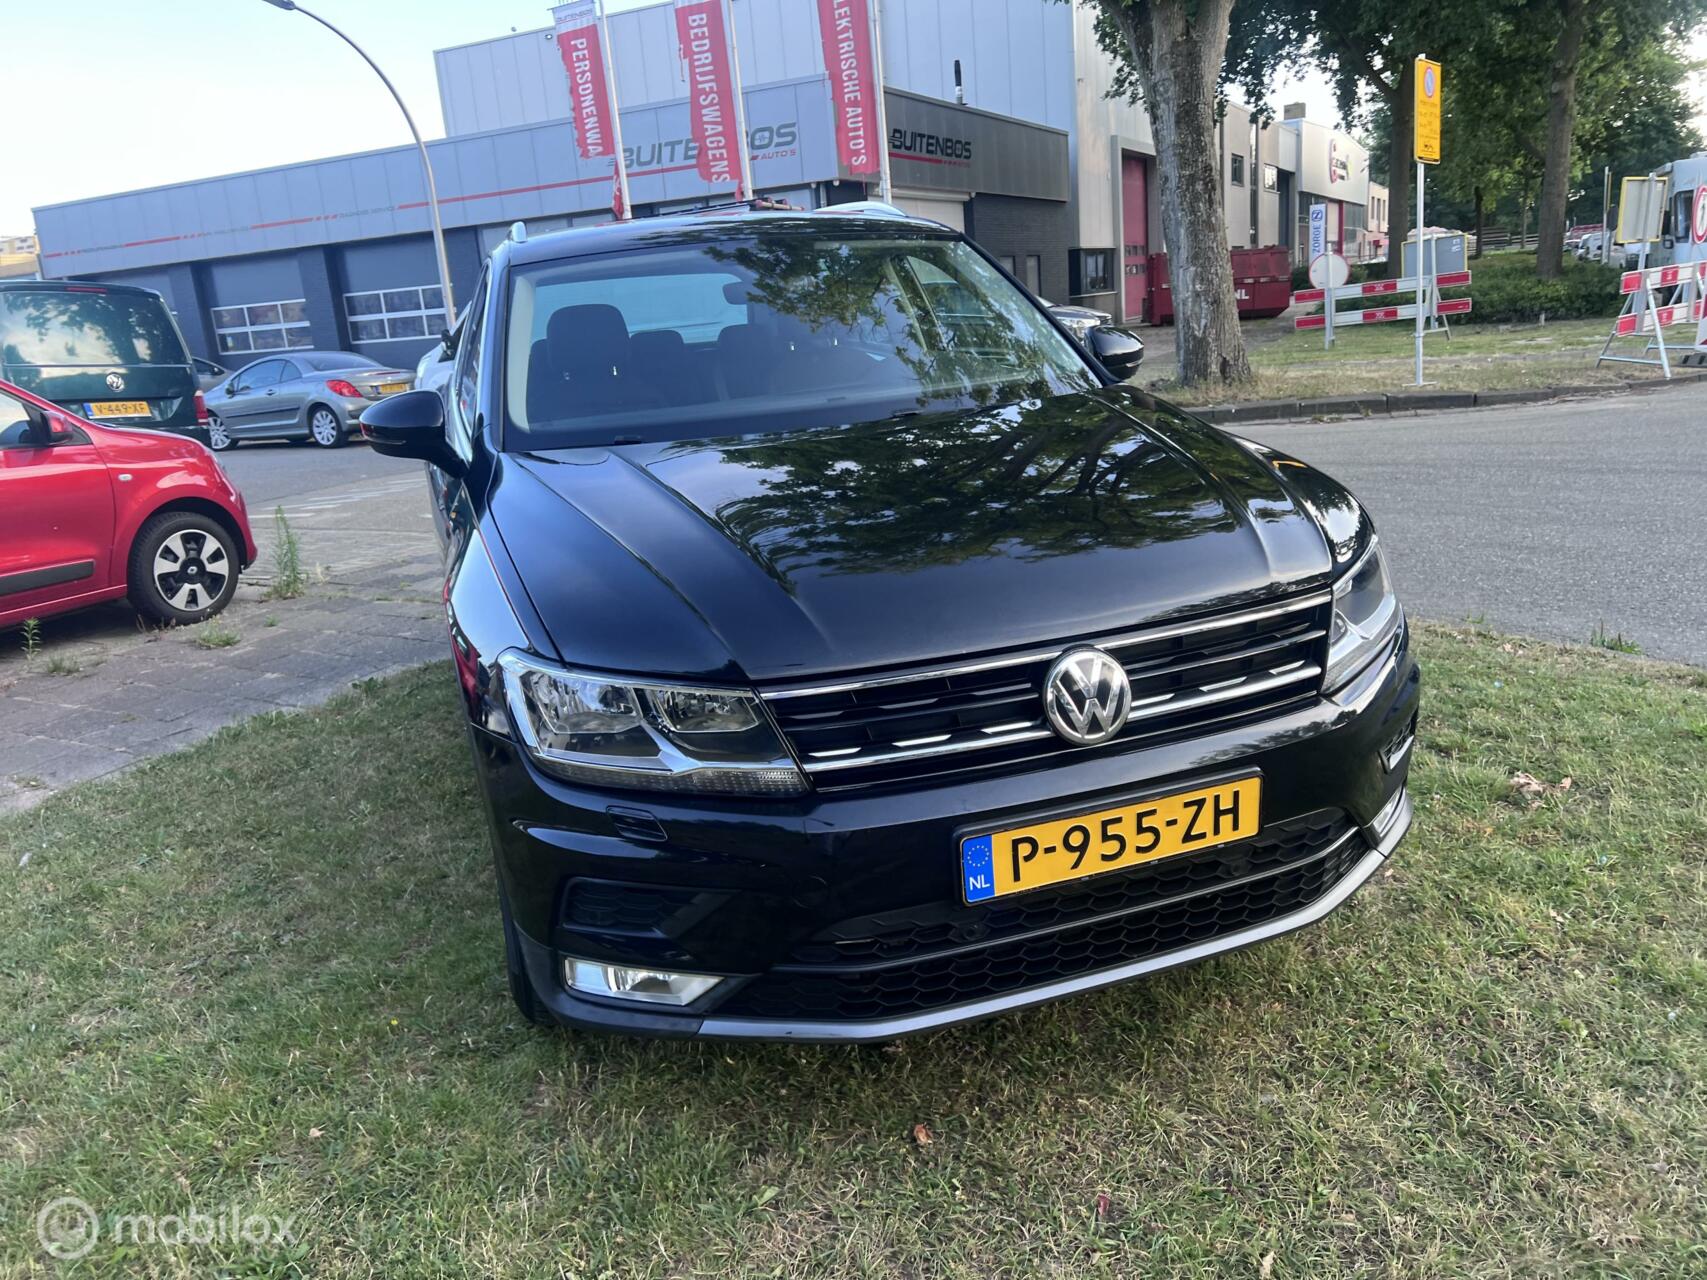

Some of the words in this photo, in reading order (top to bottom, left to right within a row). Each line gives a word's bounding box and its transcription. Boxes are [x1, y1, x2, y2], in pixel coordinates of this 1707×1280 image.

[570, 38, 603, 157] PERSONENWA
[687, 13, 731, 183] BEDRIJFSWAGENS
[845, 107, 867, 166] AUTO'S
[889, 127, 972, 160] BUITENBOS
[968, 874, 991, 891] NL
[1011, 788, 1241, 883] P-955-ZH
